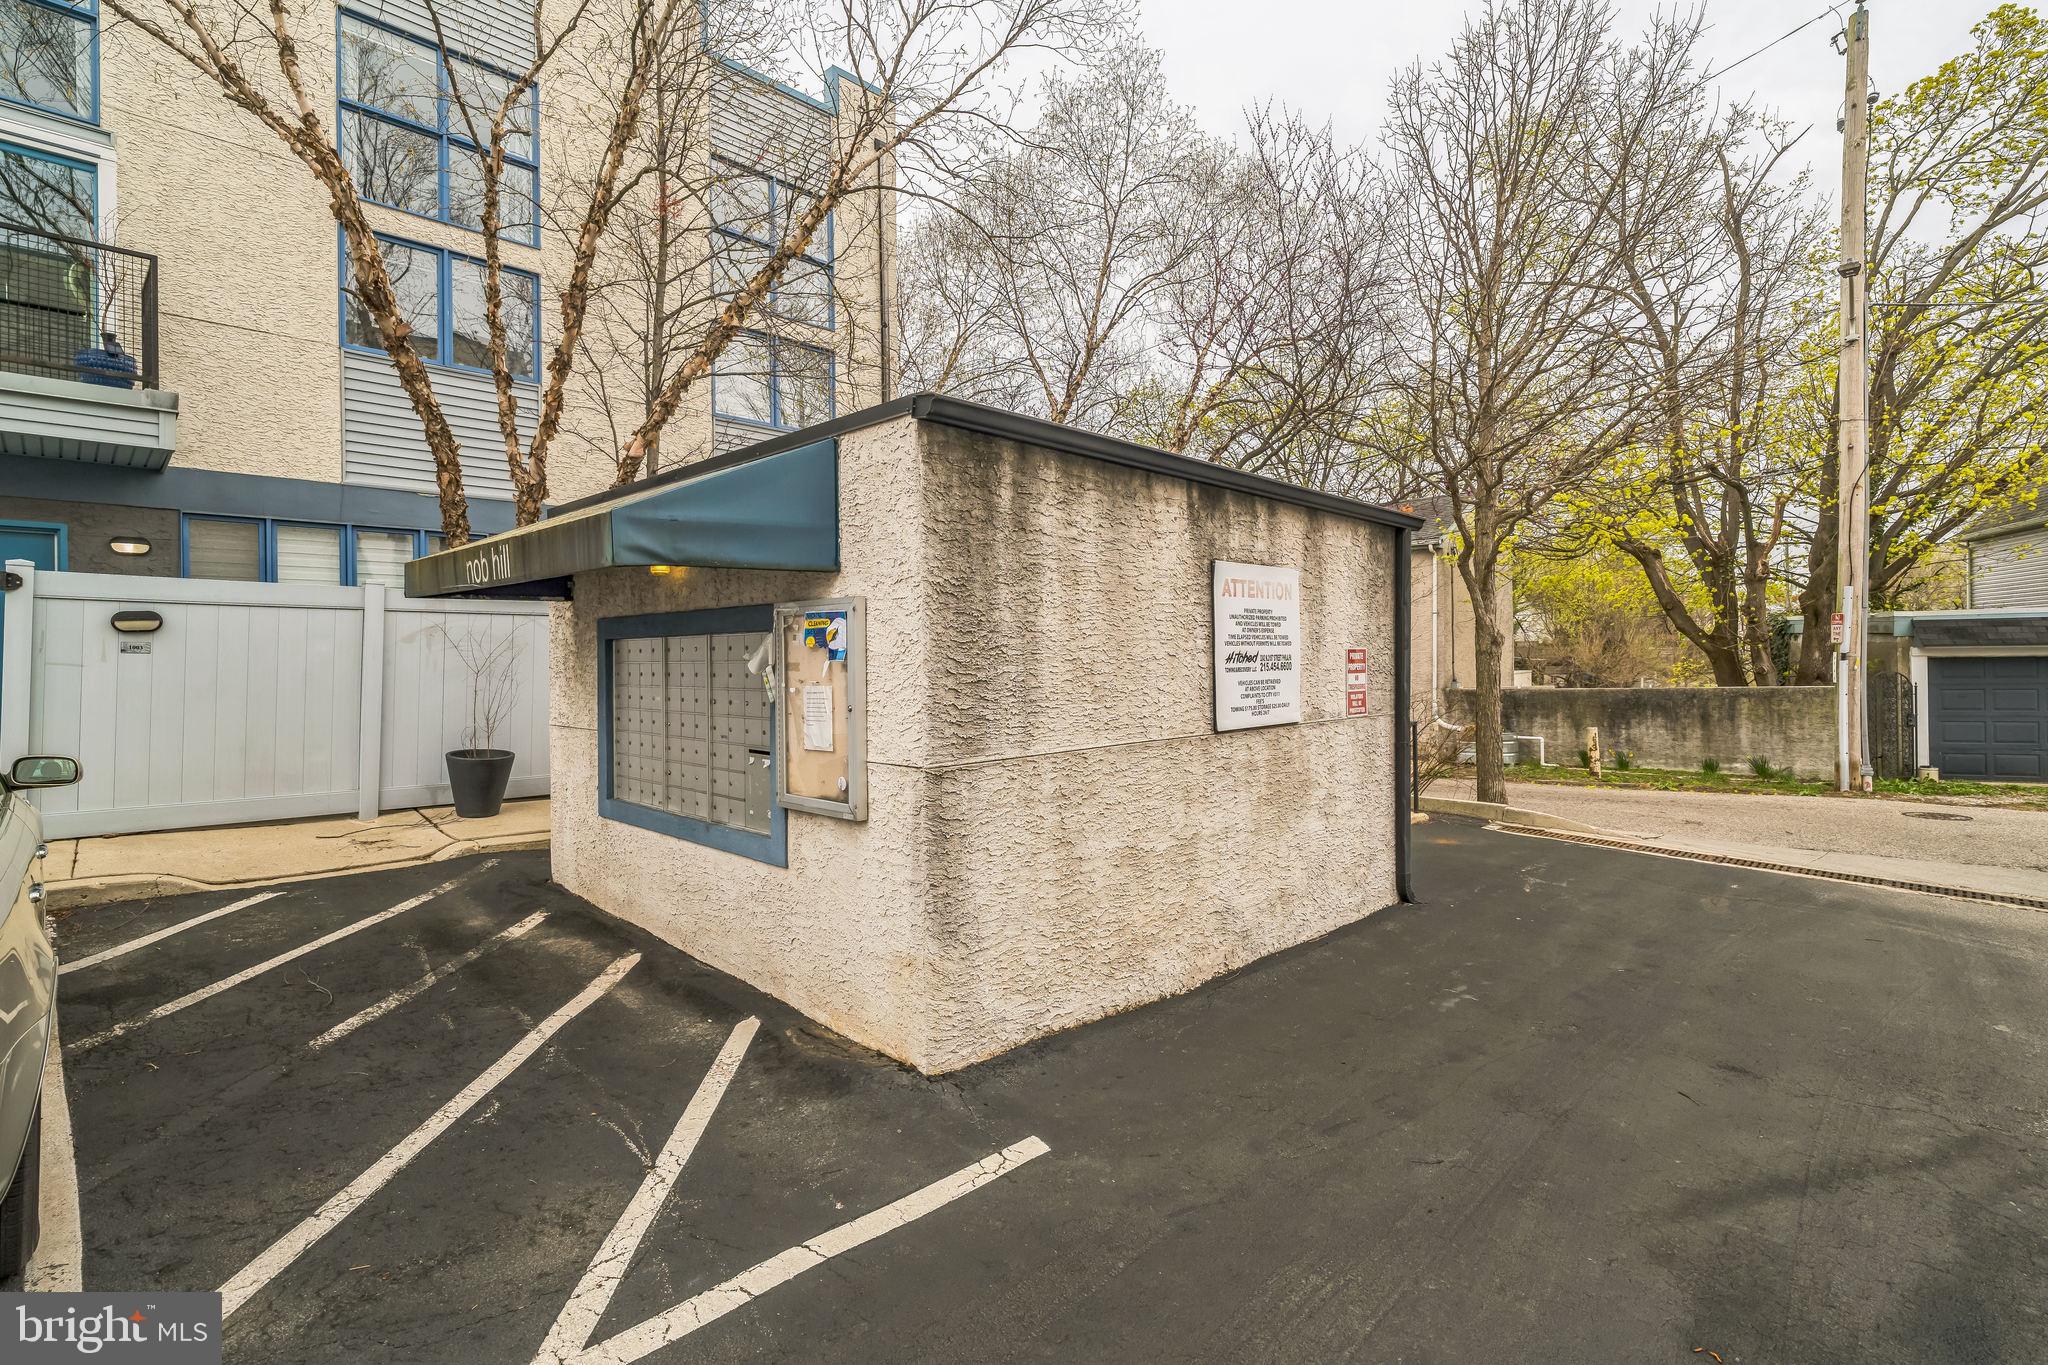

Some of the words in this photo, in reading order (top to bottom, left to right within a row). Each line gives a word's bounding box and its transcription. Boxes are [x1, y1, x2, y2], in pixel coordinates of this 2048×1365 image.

[466, 550, 489, 584] nob
[491, 544, 511, 581] hill
[1222, 577, 1292, 600] ATTENTION
[1225, 650, 1259, 665] Hitched
[1260, 661, 1293, 672] 215.454.6600
